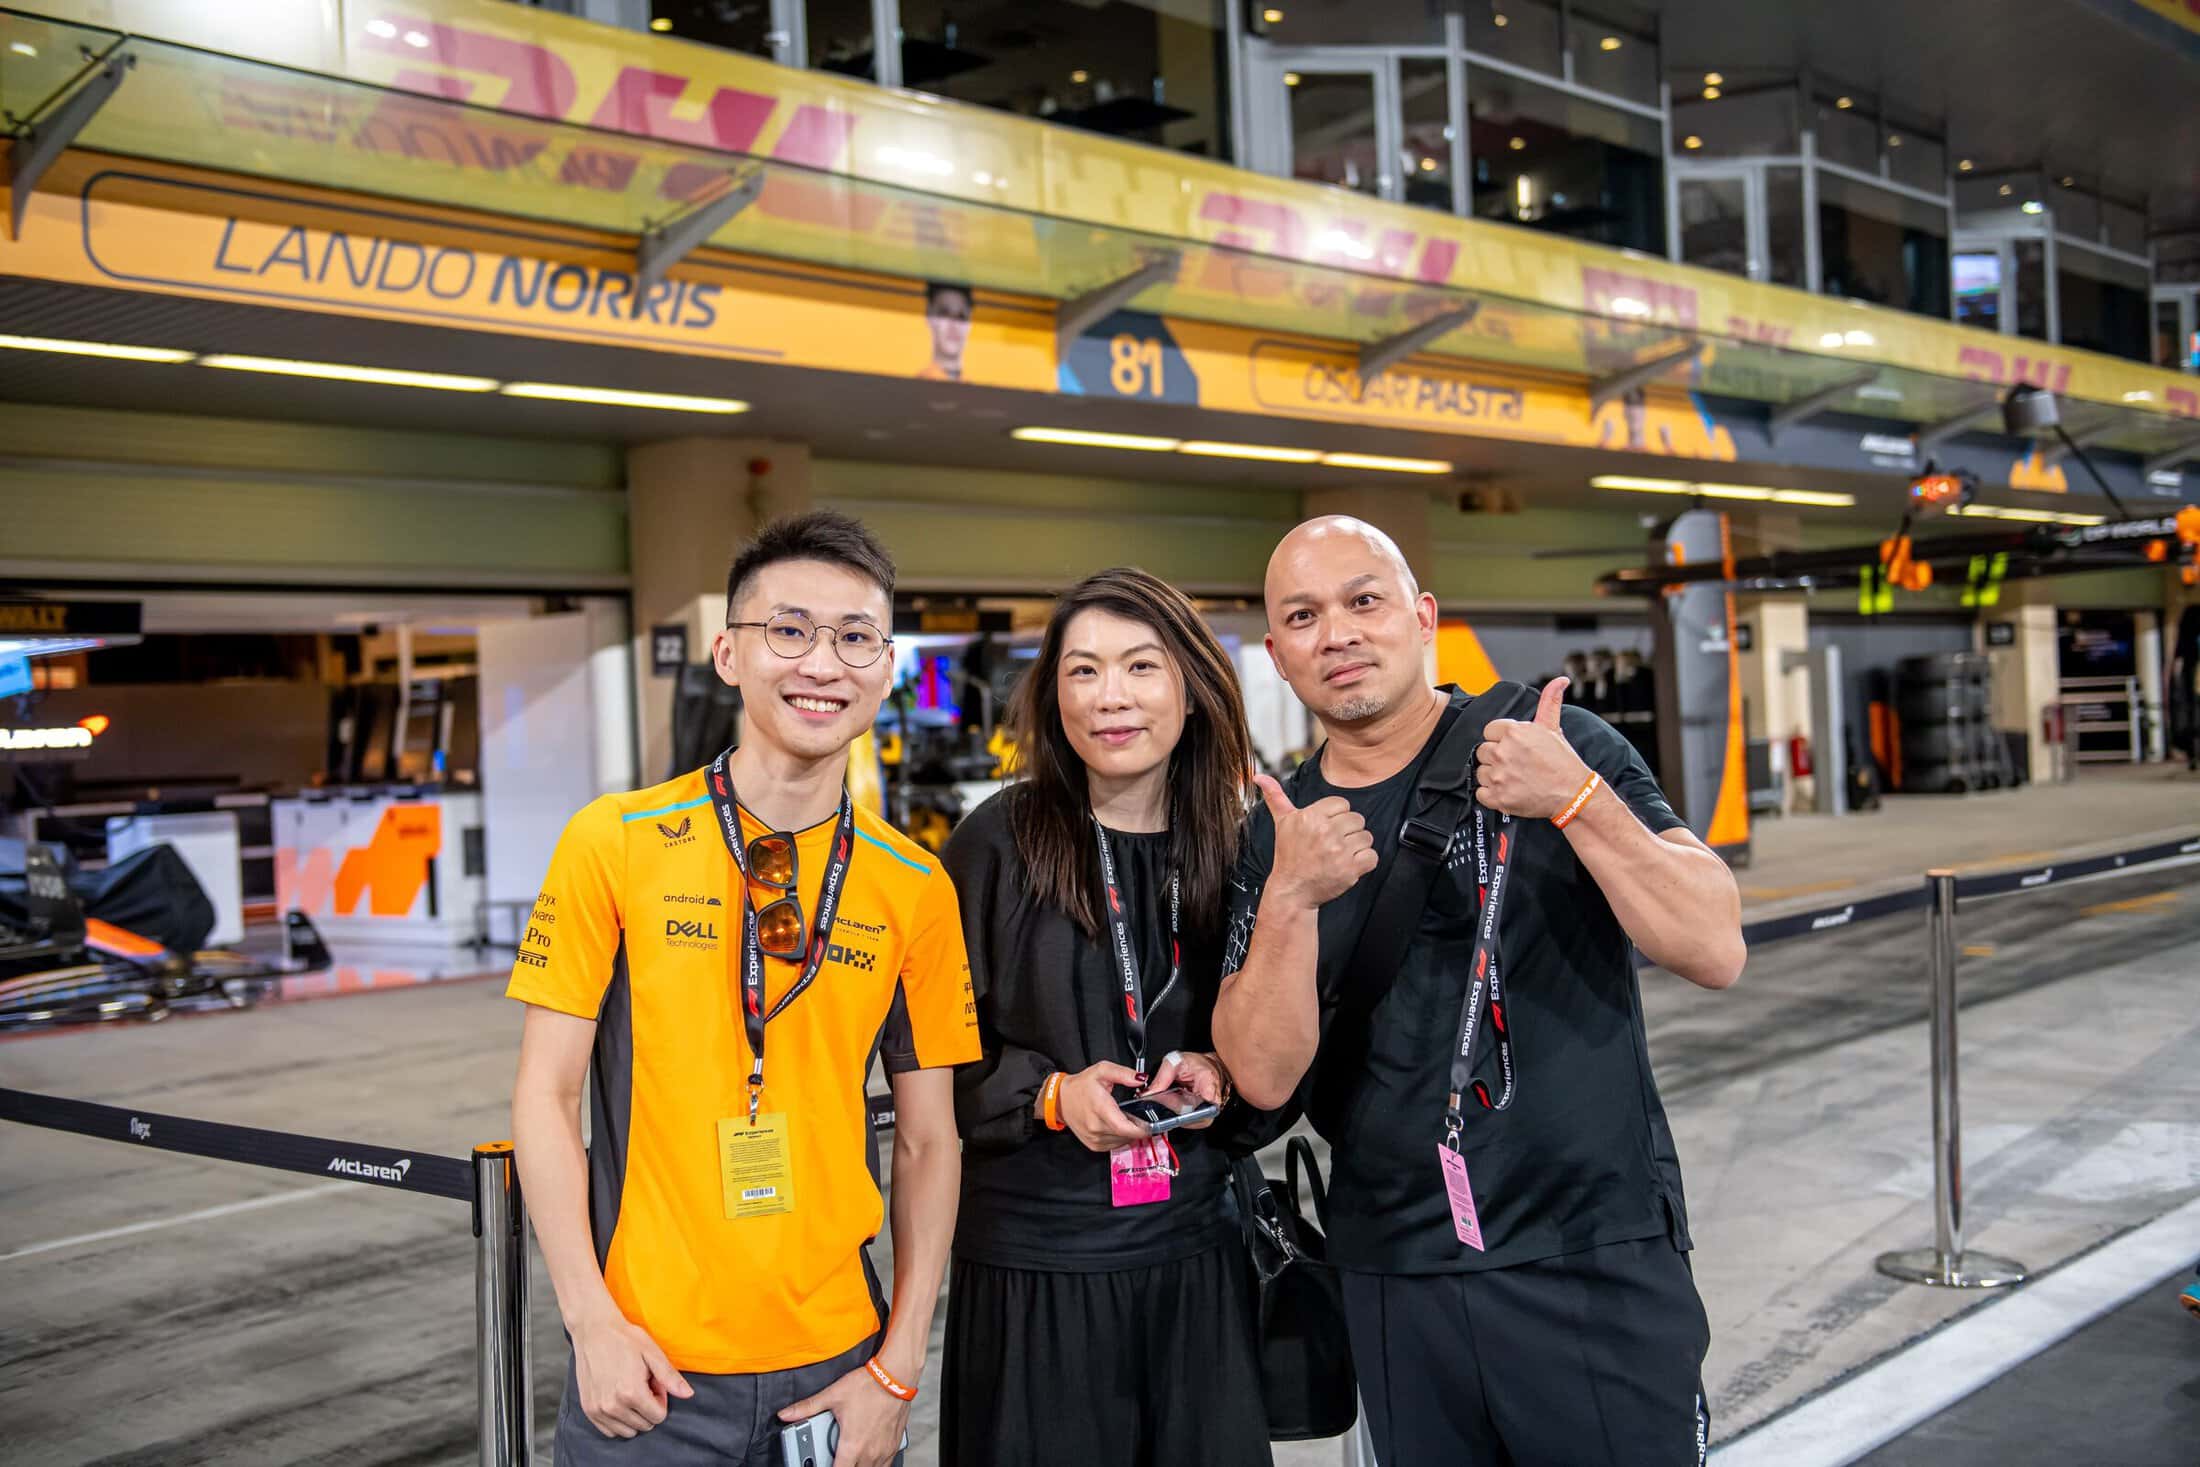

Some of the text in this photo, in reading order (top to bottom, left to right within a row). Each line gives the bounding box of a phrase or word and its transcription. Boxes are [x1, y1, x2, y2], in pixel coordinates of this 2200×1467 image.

[214, 216, 722, 328] LANDO NORRIS
[1110, 333, 1164, 397] 81
[663, 893, 705, 904] android
[666, 920, 718, 939] DELL
[820, 862, 843, 931] Experiences
[1483, 865, 1505, 940] Experiences
[522, 926, 551, 948] Pro
[1116, 921, 1134, 992] Experiences
[1461, 981, 1483, 1057] Experiences
[328, 1158, 402, 1181] McLaren
